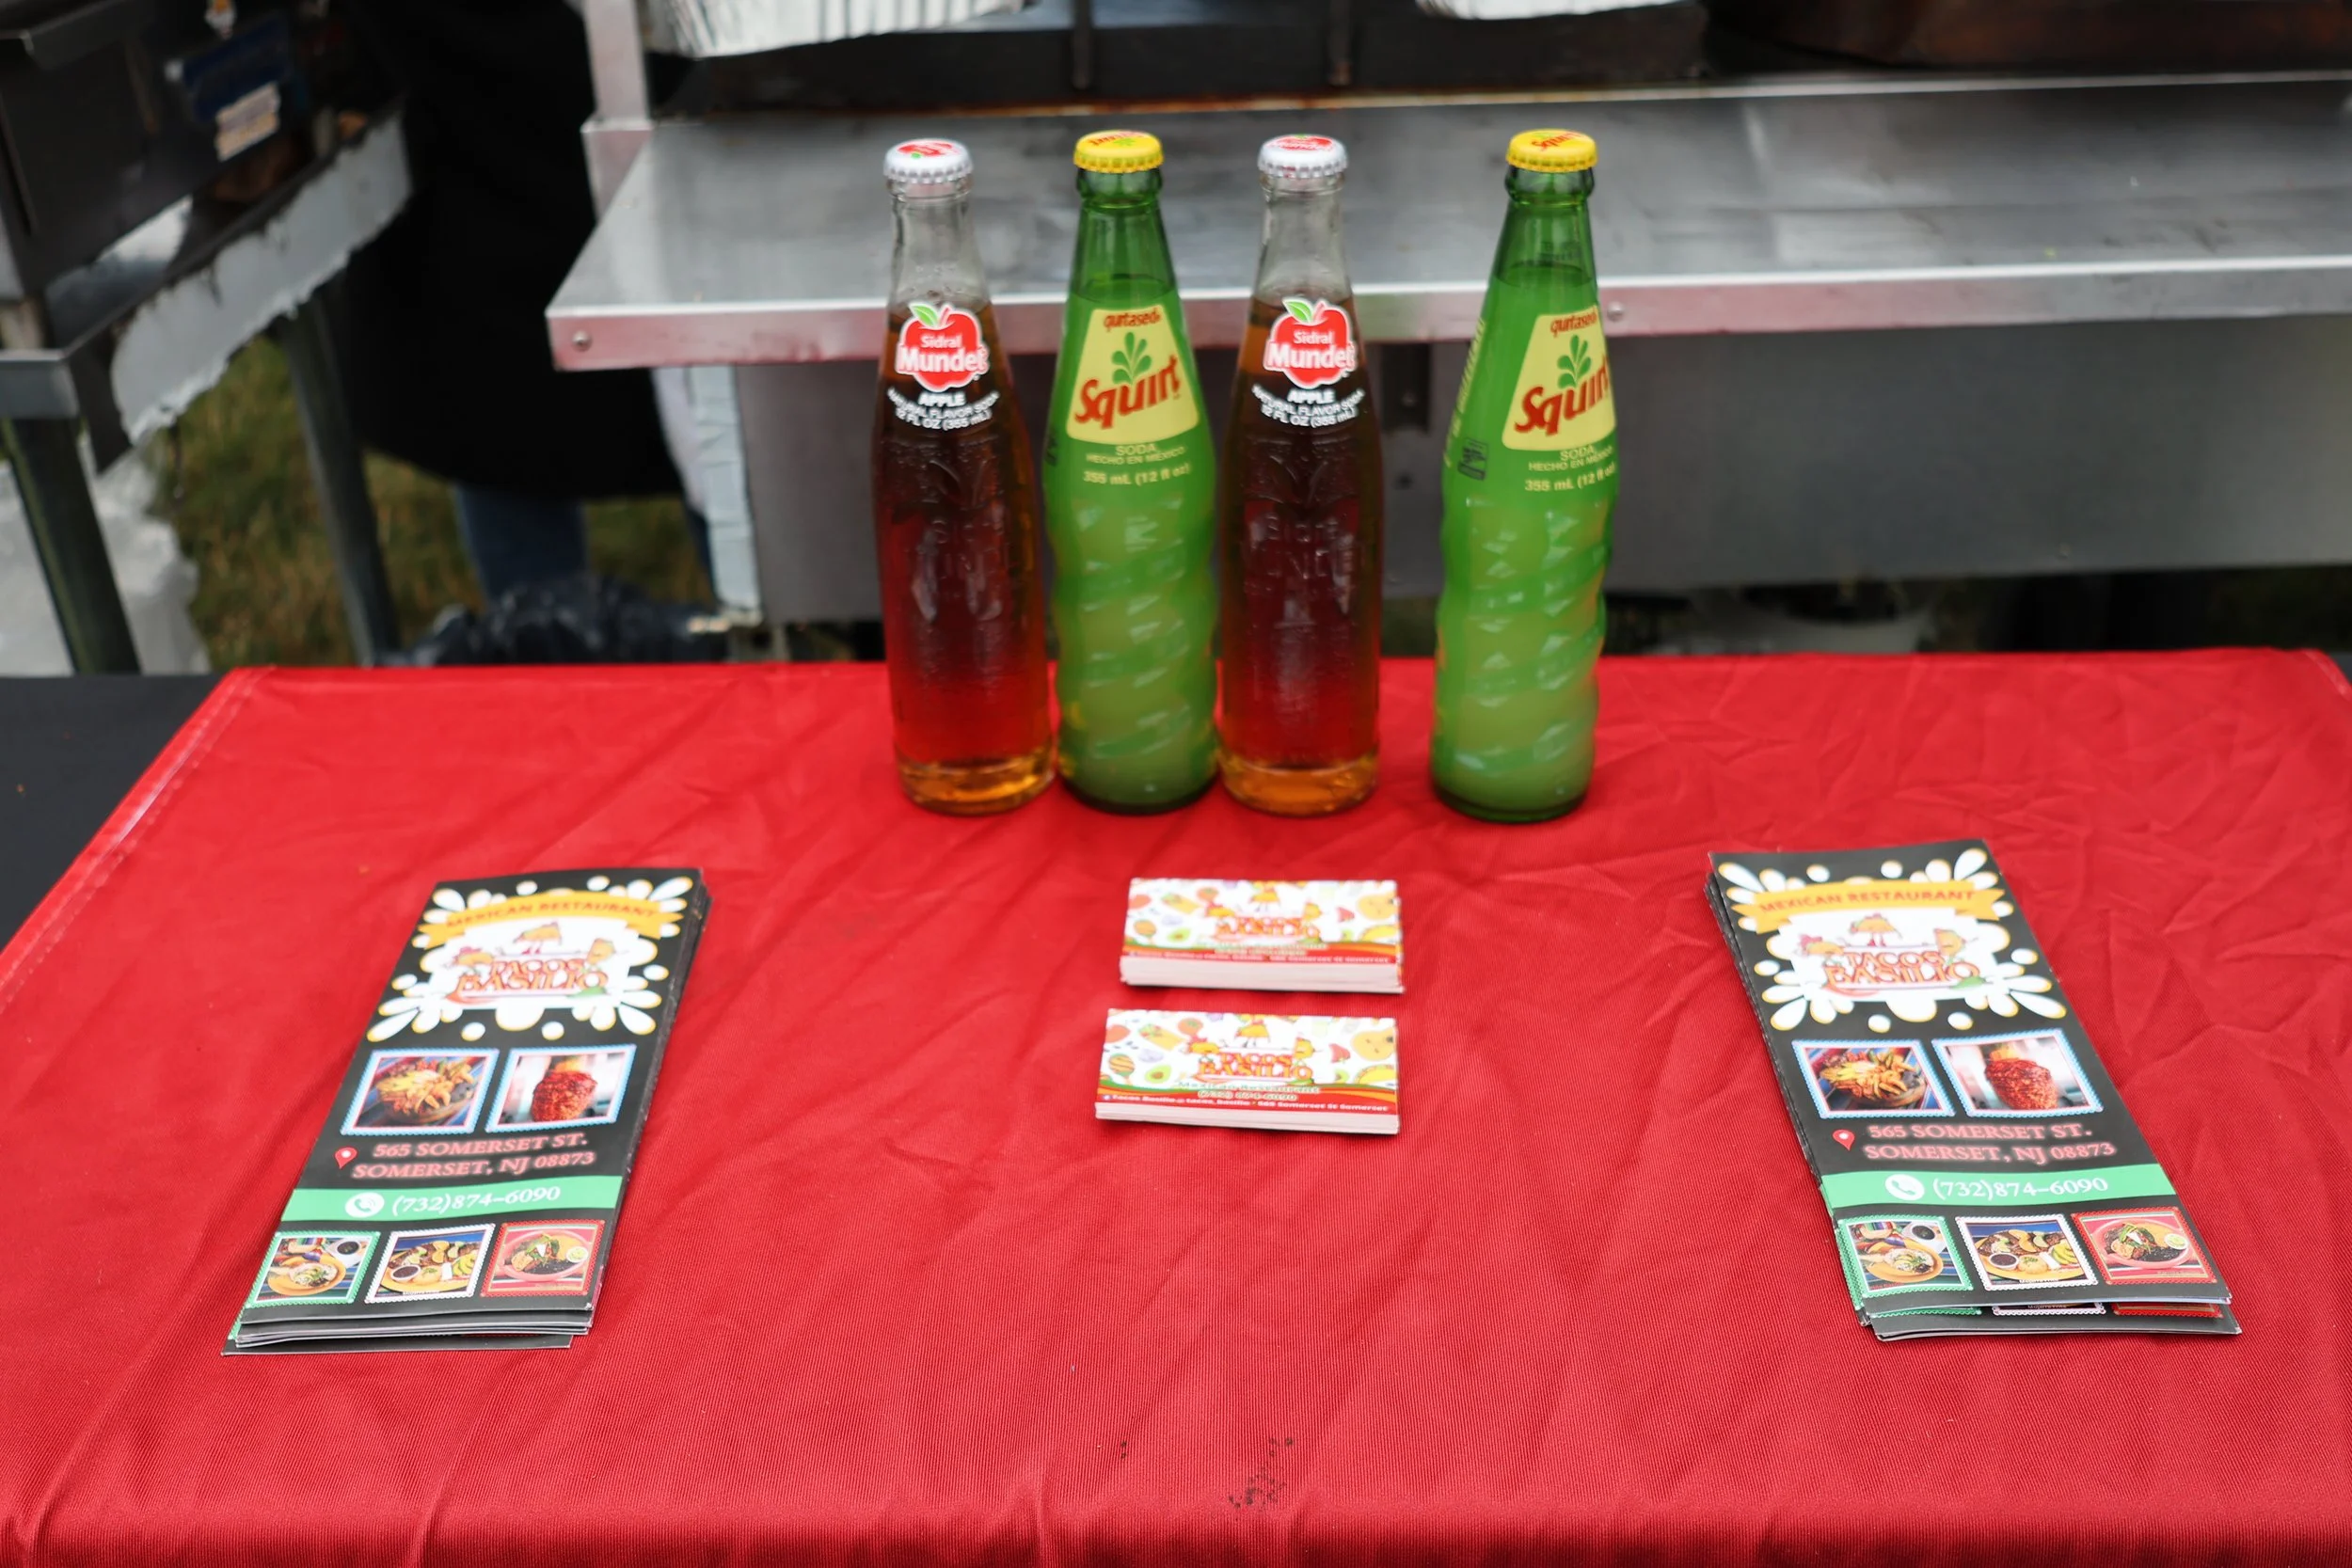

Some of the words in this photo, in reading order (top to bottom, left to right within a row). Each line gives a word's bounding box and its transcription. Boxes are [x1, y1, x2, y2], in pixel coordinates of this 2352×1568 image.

[920, 333, 962, 348] Sidral
[1294, 331, 1334, 344] Sidral
[898, 345, 988, 372] Mundet
[1267, 343, 1356, 369] Mundet
[918, 392, 965, 407] APPLE
[1074, 355, 1180, 430] Squirt
[1287, 389, 1335, 404] APPLE
[1273, 410, 1290, 423] FL
[1290, 416, 1310, 427] OZ
[1310, 417, 1337, 428] (355
[1297, 404, 1341, 417] FLAVOR
[922, 417, 942, 430] OZ
[943, 419, 970, 431] (355
[1116, 443, 1156, 456] SODA
[1560, 444, 1595, 461] SODA
[1086, 453, 1125, 465] HECHO
[1126, 455, 1144, 465] EN
[1528, 461, 1568, 471] HECHO
[1569, 458, 1585, 468] EN
[1083, 471, 1107, 484] 355
[1135, 470, 1158, 486] (12
[1525, 479, 1550, 492] 355
[1577, 472, 1596, 489] (12
[538, 900, 660, 918] RESTAURANT
[1759, 894, 1842, 913] MEXICAN
[1848, 889, 1976, 904] RESTAURANT
[489, 958, 586, 974] TACOS
[1843, 951, 1945, 969] TACOS
[455, 971, 609, 990] BASILIO
[1821, 962, 1980, 985] BASILIO
[1220, 1052, 1293, 1065] TACOS
[1198, 1062, 1313, 1079] BASILIO
[1868, 1125, 1906, 1139] 565
[1911, 1124, 2044, 1140] SOMERSET
[2050, 1122, 2093, 1139] ST.
[373, 1143, 411, 1158] 565
[415, 1136, 548, 1158] SOMERSET
[552, 1132, 588, 1148] ST.
[1863, 1145, 2011, 1164] SOMERSET,
[2011, 1146, 2050, 1166] NJ
[2050, 1142, 2117, 1161] 08873
[352, 1161, 494, 1179] SOMERSET,
[499, 1157, 531, 1176] NJ
[534, 1152, 596, 1169] 08873
